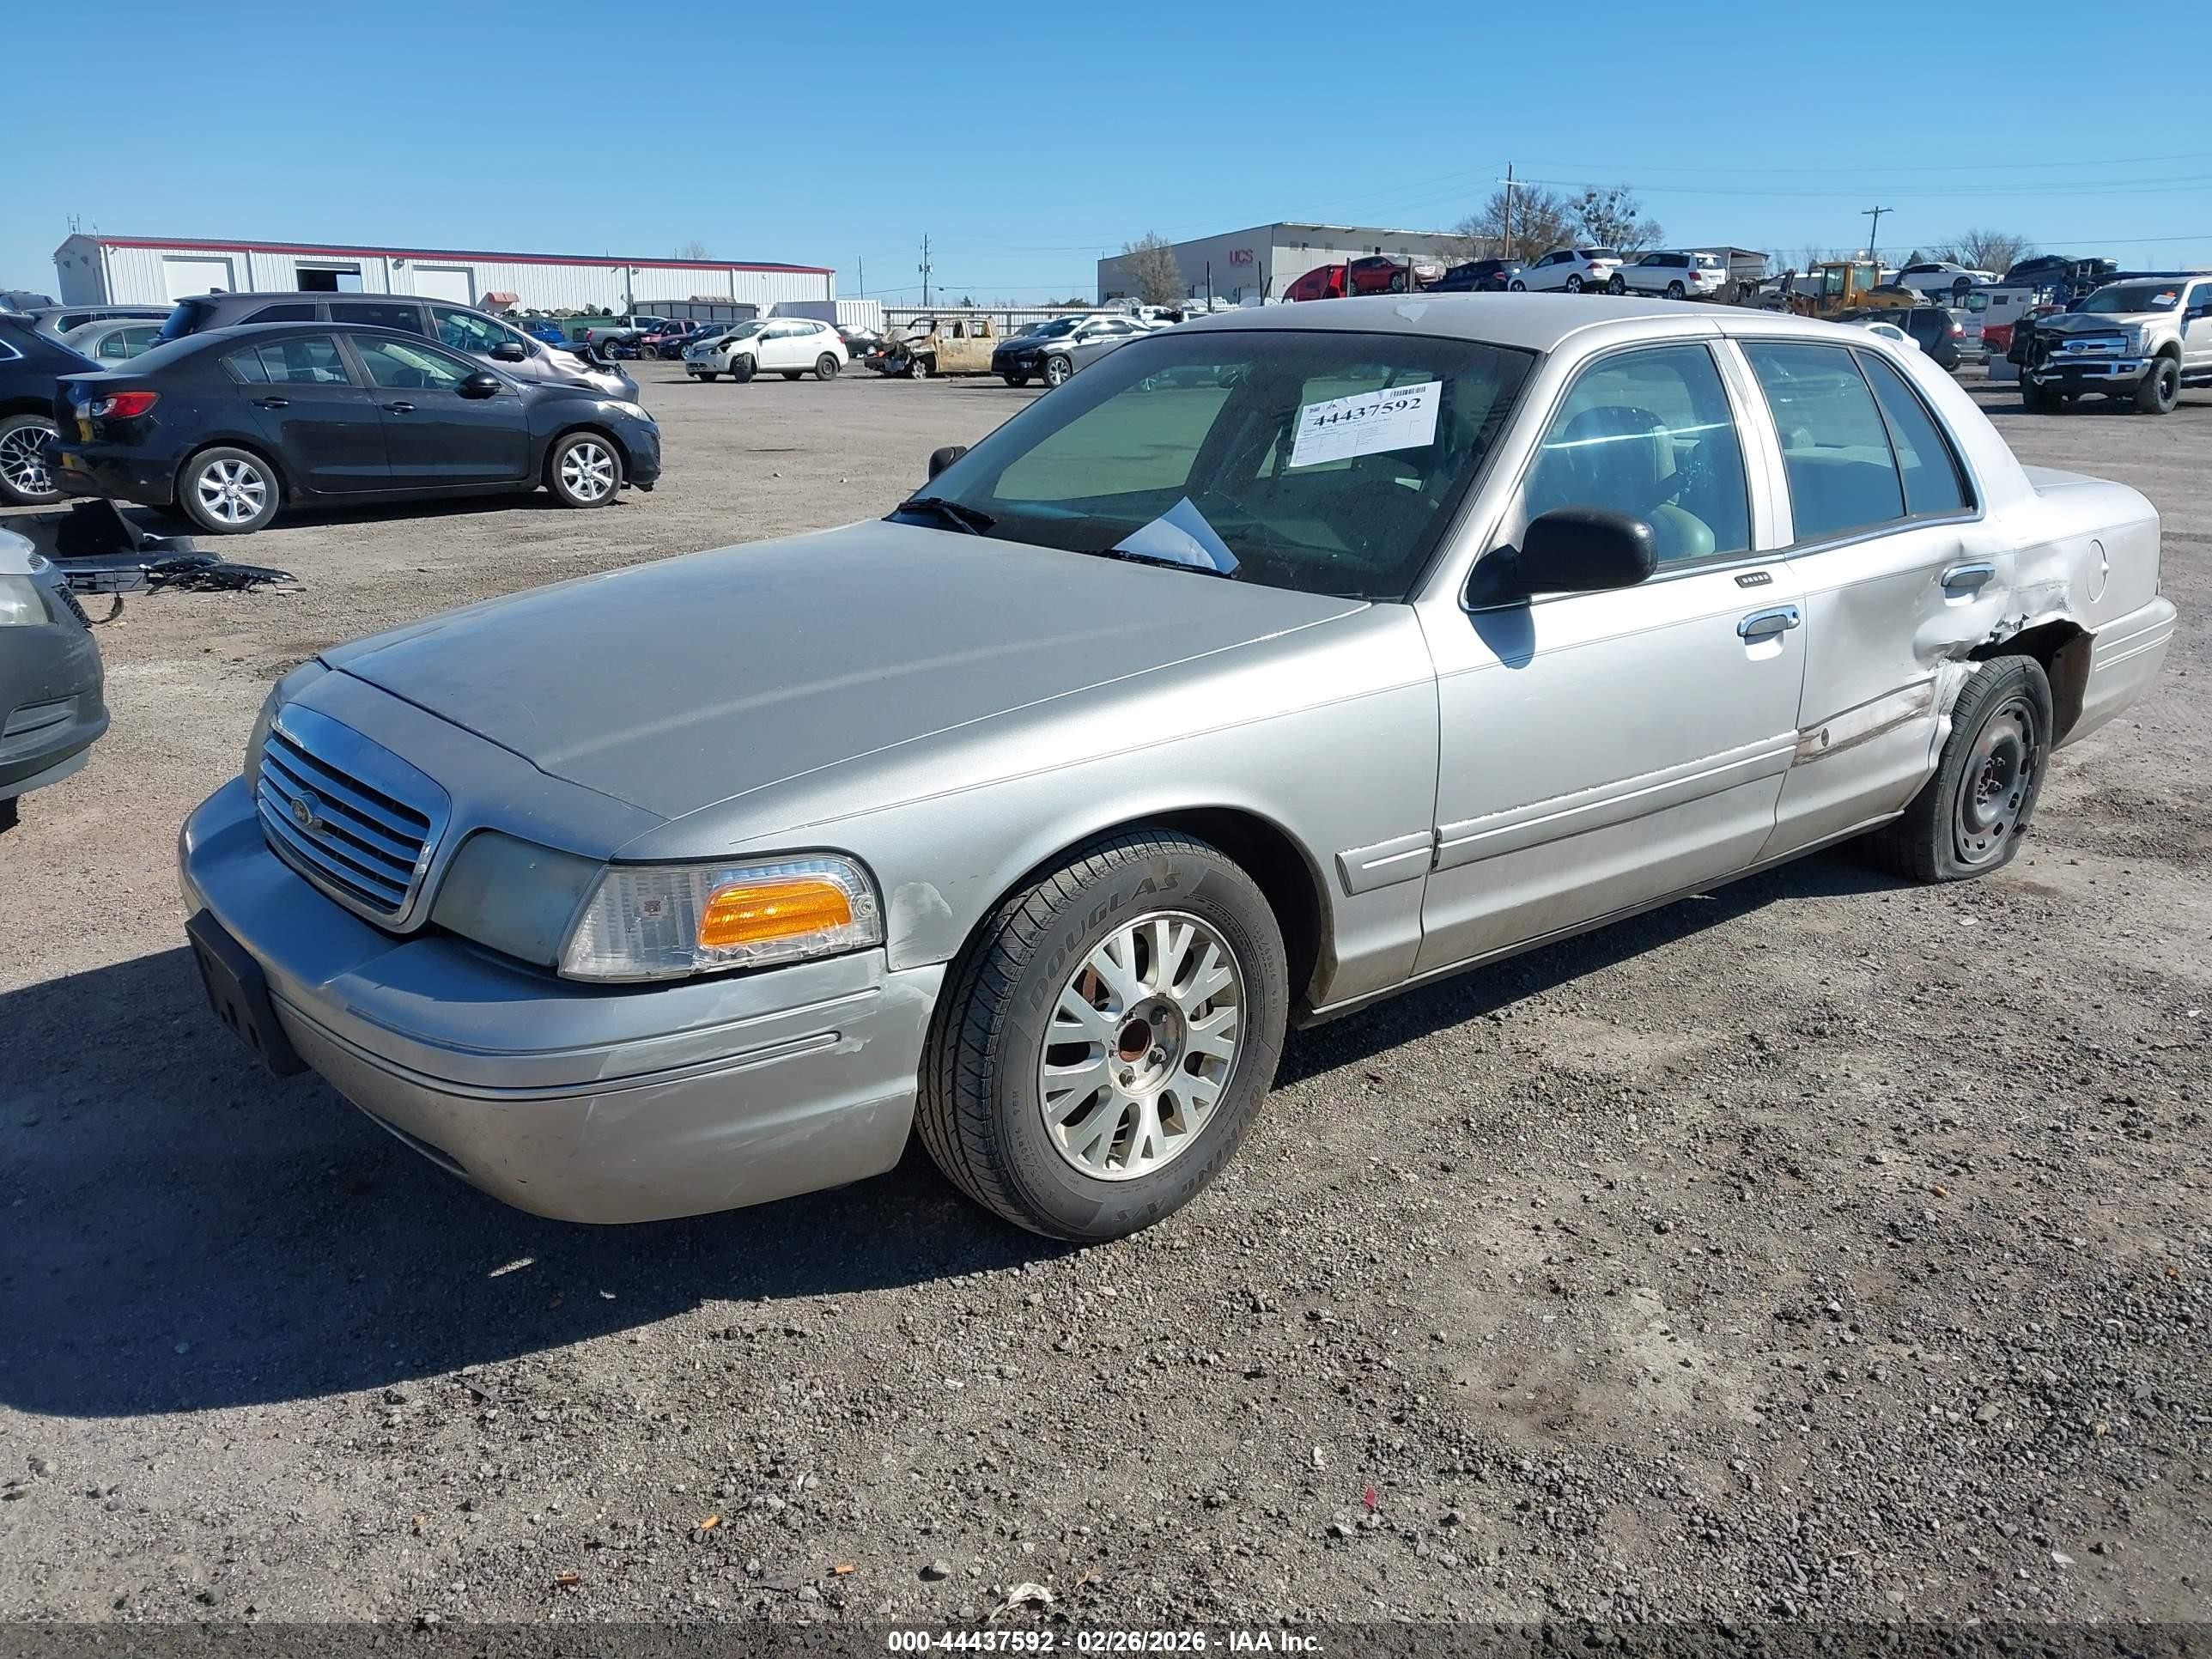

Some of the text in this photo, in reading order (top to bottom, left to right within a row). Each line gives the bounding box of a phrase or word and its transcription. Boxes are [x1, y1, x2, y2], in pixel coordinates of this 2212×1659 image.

[1230, 249, 1253, 264] UCS
[1313, 398, 1421, 427] 44437592
[1030, 872, 1182, 1012] DOUGLAS
